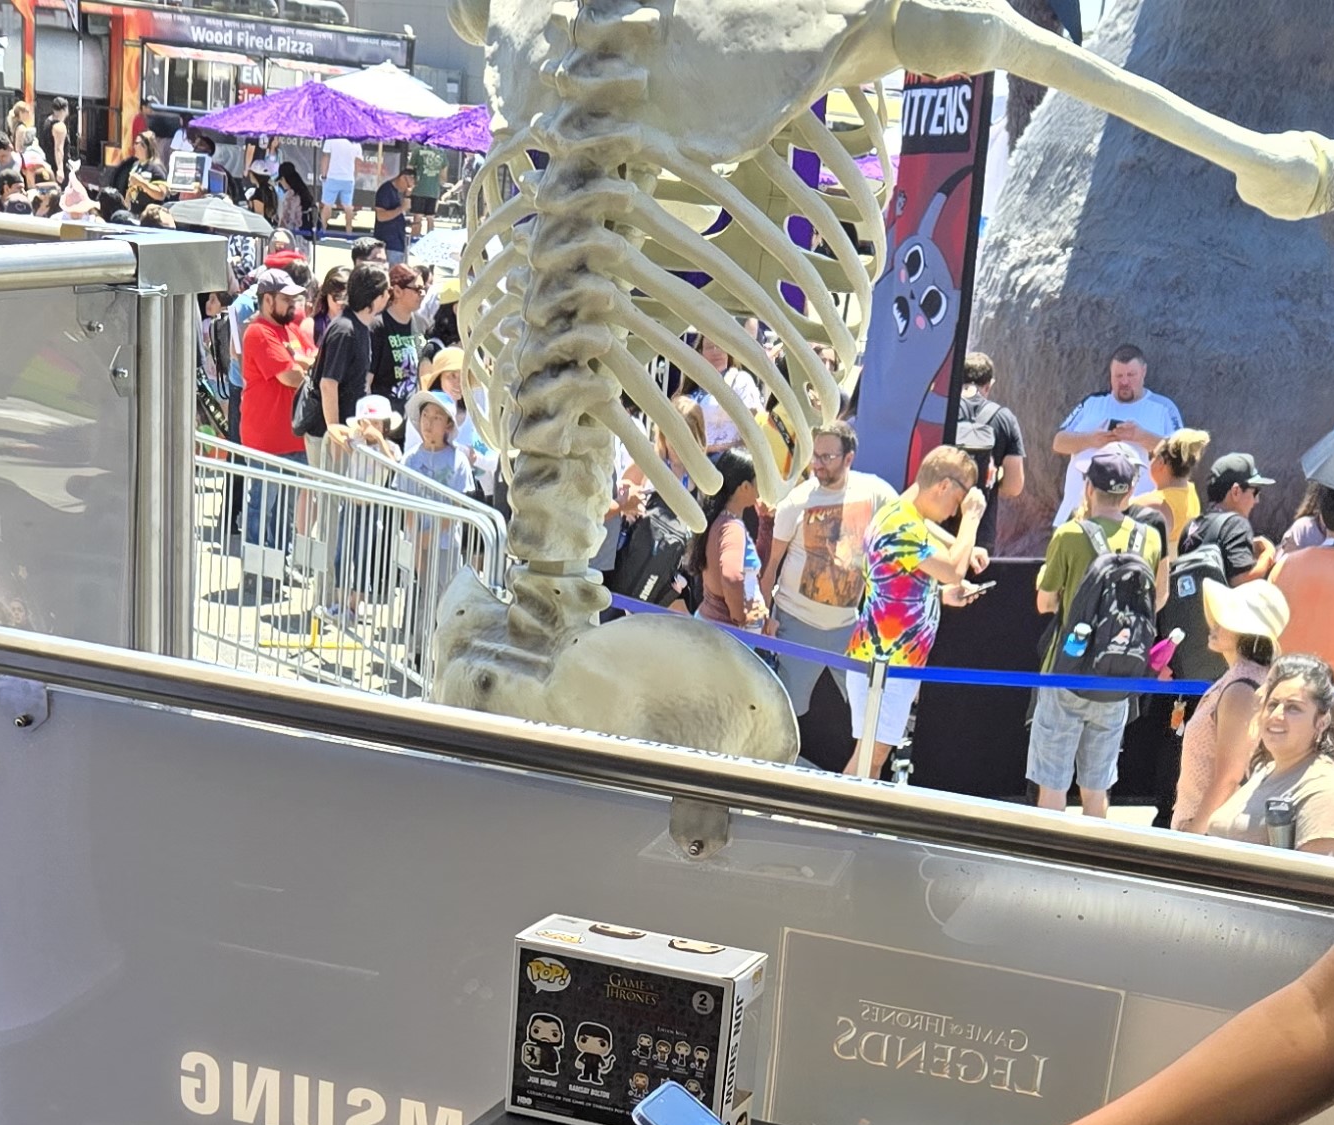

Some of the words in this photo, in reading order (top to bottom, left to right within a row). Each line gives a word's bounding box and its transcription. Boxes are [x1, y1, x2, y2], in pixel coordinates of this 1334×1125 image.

[191, 26, 233, 46] Wood
[237, 33, 274, 52] Fired
[277, 37, 314, 56] Pizza
[903, 84, 973, 137] ITTENS
[527, 960, 570, 986] POP!
[609, 972, 645, 990] GAME
[604, 983, 659, 1006] THRONES
[698, 993, 707, 1006] 2
[733, 994, 745, 1038] JON
[528, 1075, 539, 1084] JON
[540, 1078, 558, 1089] SNOW
[724, 1042, 738, 1106] SNOW
[516, 1095, 533, 1106] HBO
[568, 1083, 590, 1095] RAMSAY
[590, 1088, 611, 1099] BOLTON
